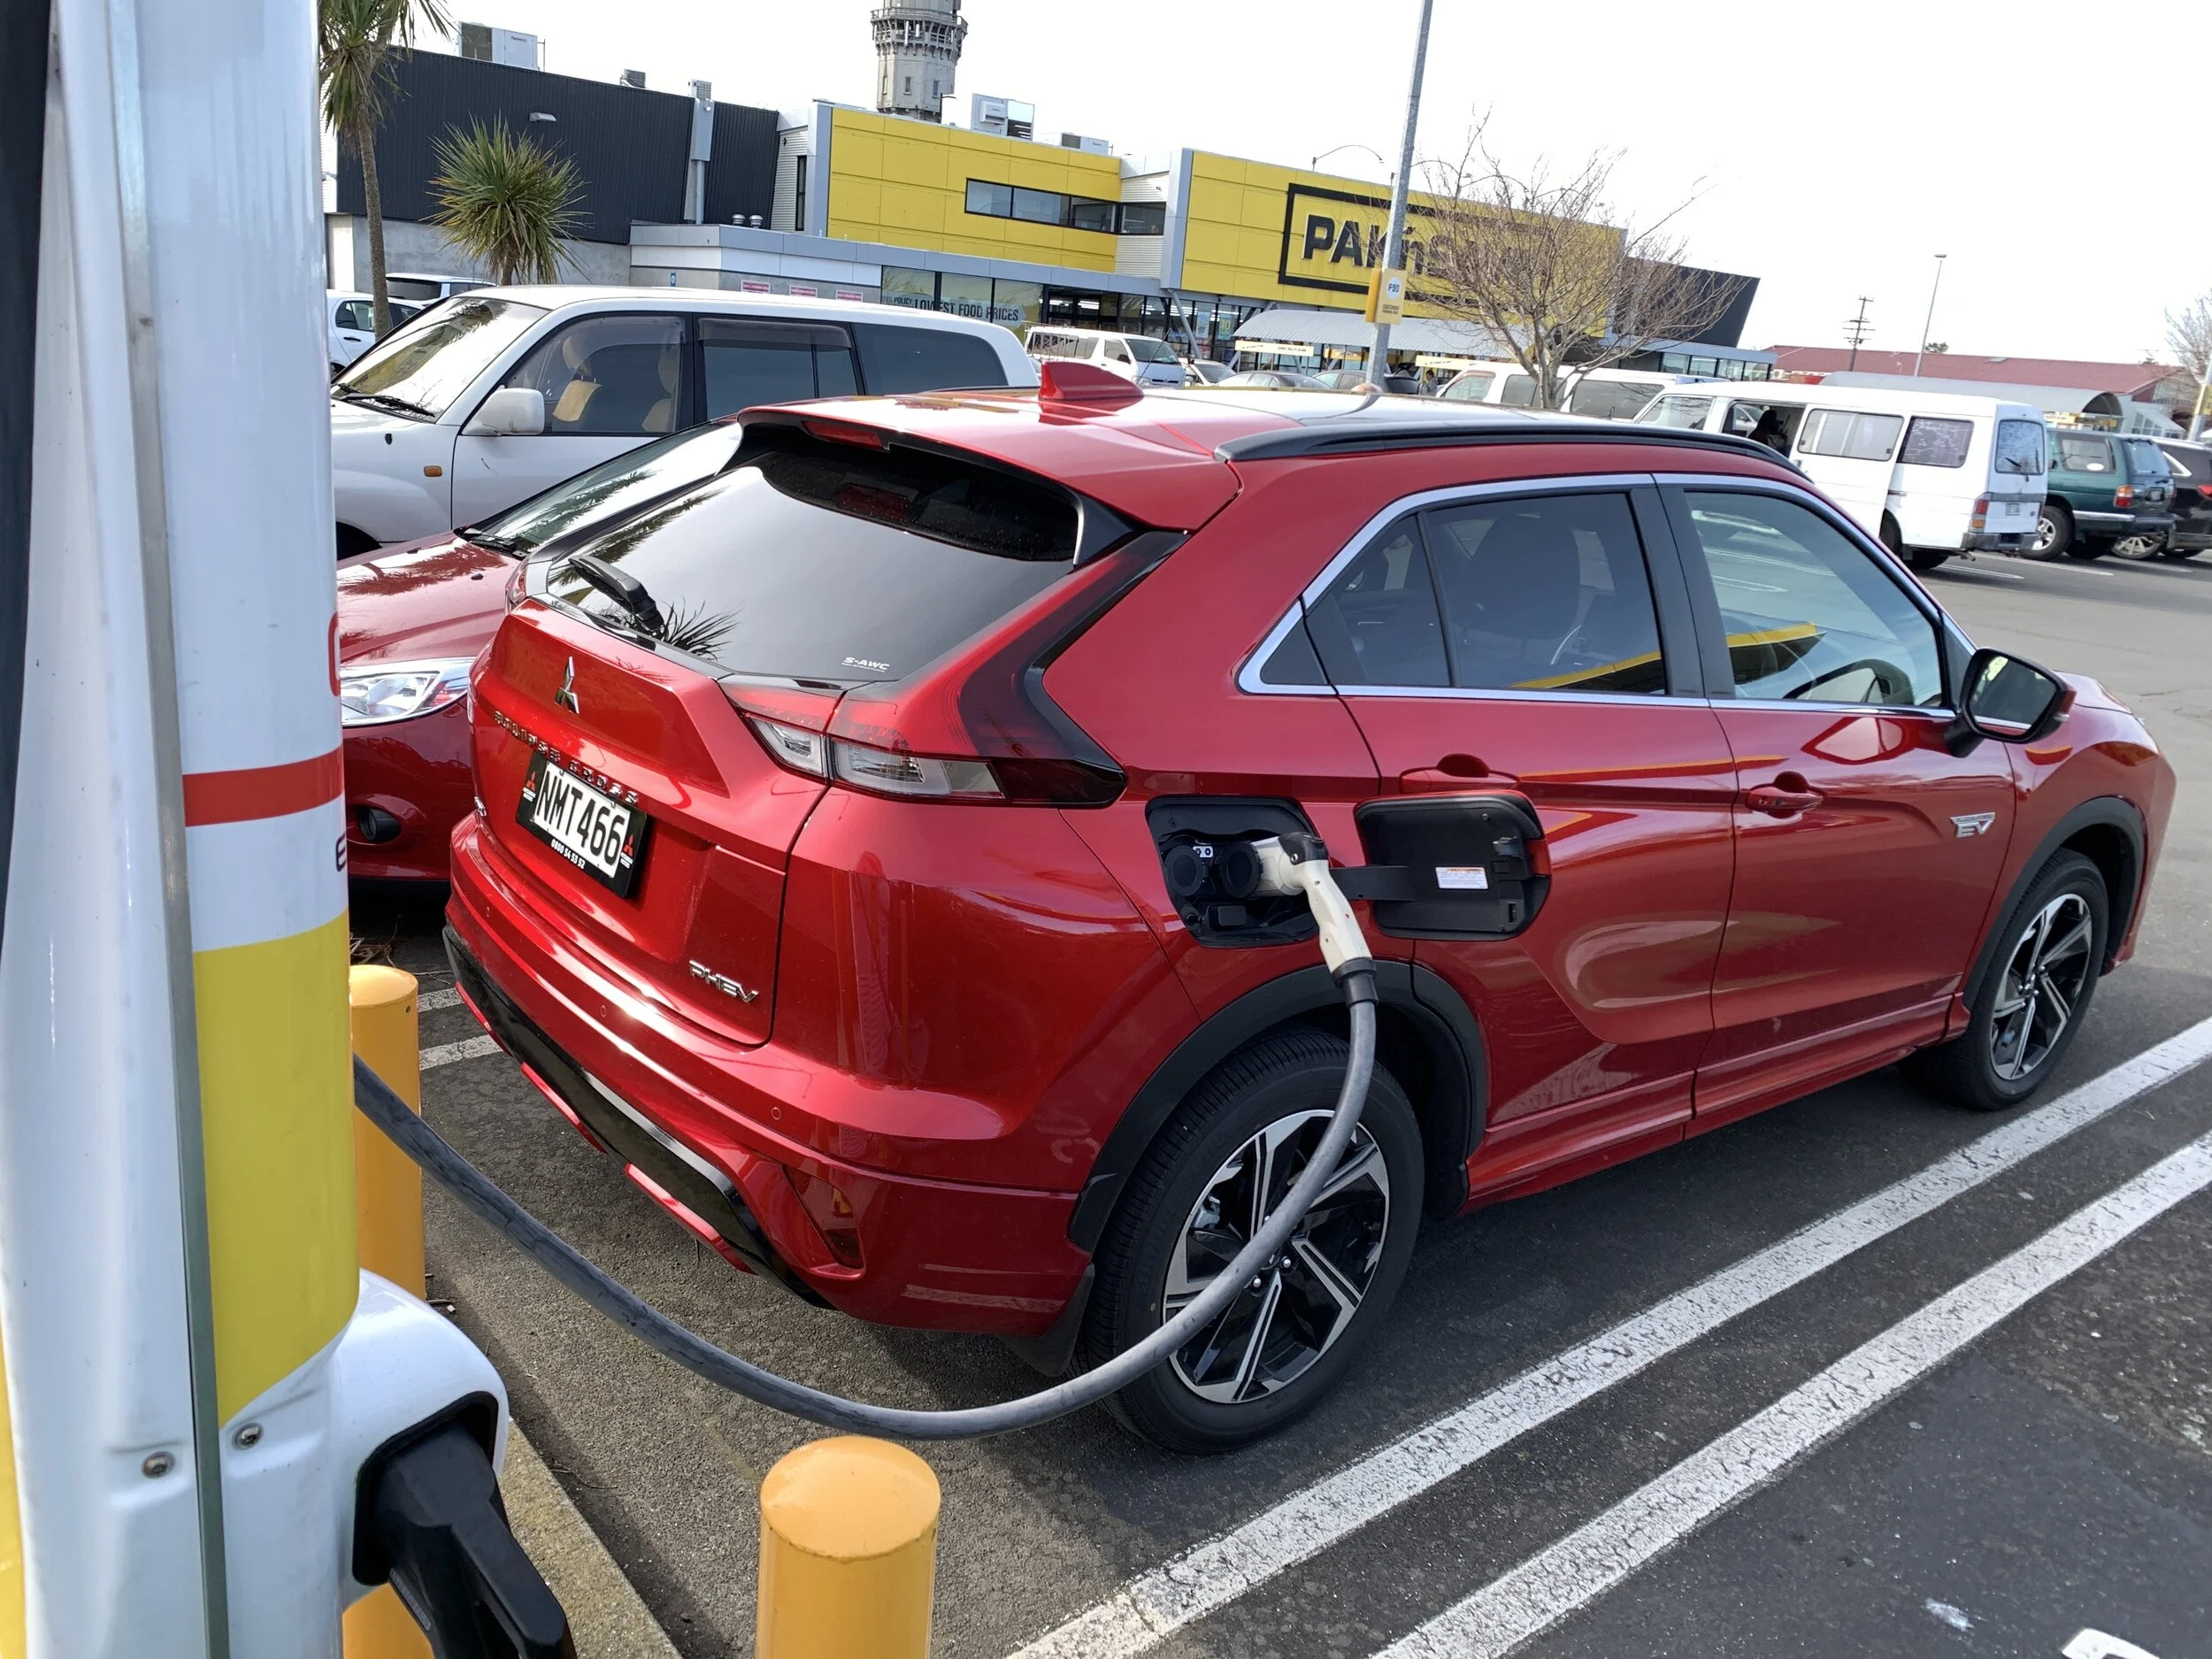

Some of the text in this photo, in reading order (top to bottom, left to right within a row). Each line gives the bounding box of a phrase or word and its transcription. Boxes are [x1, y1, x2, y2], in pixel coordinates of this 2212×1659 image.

[1388, 283, 1401, 293] P90
[958, 303, 983, 319] FOOD
[986, 307, 1019, 321] PRICES
[843, 657, 890, 671] S-AWC
[494, 710, 640, 805] ECLIPSE CROSS
[536, 770, 626, 866] NMT466
[551, 838, 565, 855] 0800
[688, 959, 759, 1002] PHEV
